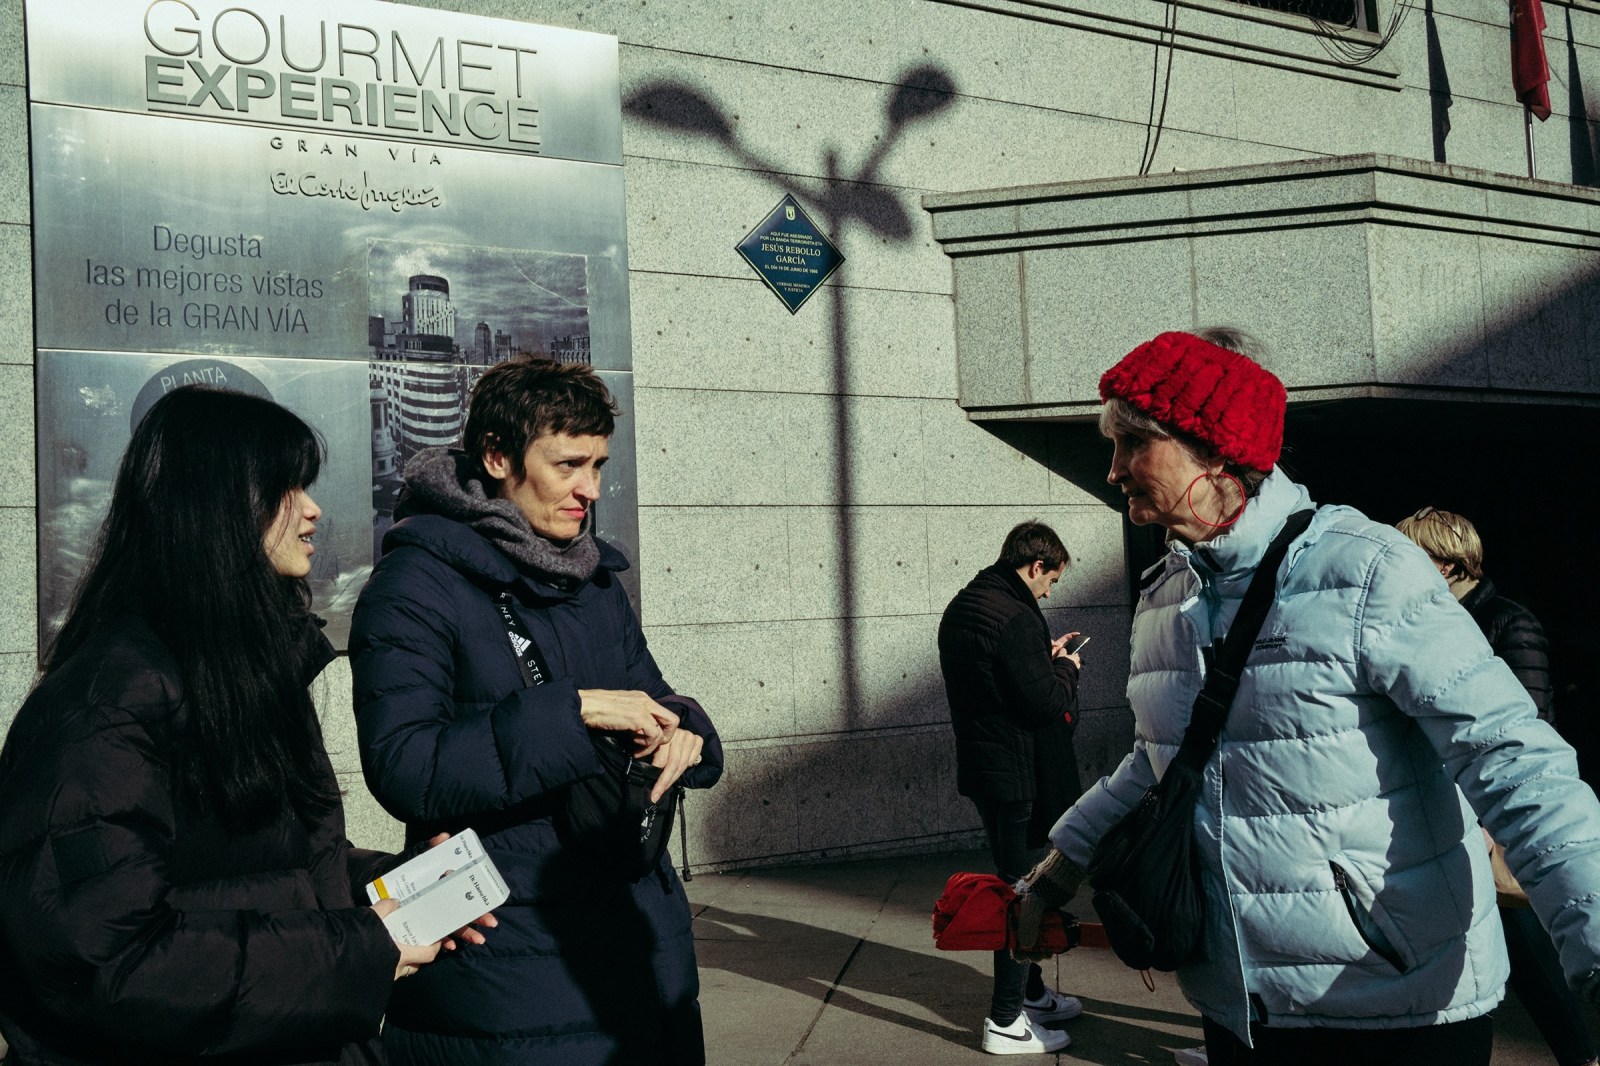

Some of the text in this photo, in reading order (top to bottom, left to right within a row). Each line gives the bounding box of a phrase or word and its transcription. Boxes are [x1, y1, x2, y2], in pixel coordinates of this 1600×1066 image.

[144, 0, 537, 98] GOURMET
[145, 55, 540, 145] EXPERIENCE
[270, 136, 357, 157] GRAN
[270, 171, 298, 195] El
[298, 173, 359, 201] Corte
[153, 225, 262, 260] Degusta
[761, 243, 821, 257] JESÚS REBOLLO
[776, 255, 805, 265] GARCÍA
[86, 258, 324, 299] las mejores vistas
[104, 298, 310, 334] de la GRAN VÍA
[508, 631, 523, 657] adidas
[473, 882, 489, 906] Hauschka
